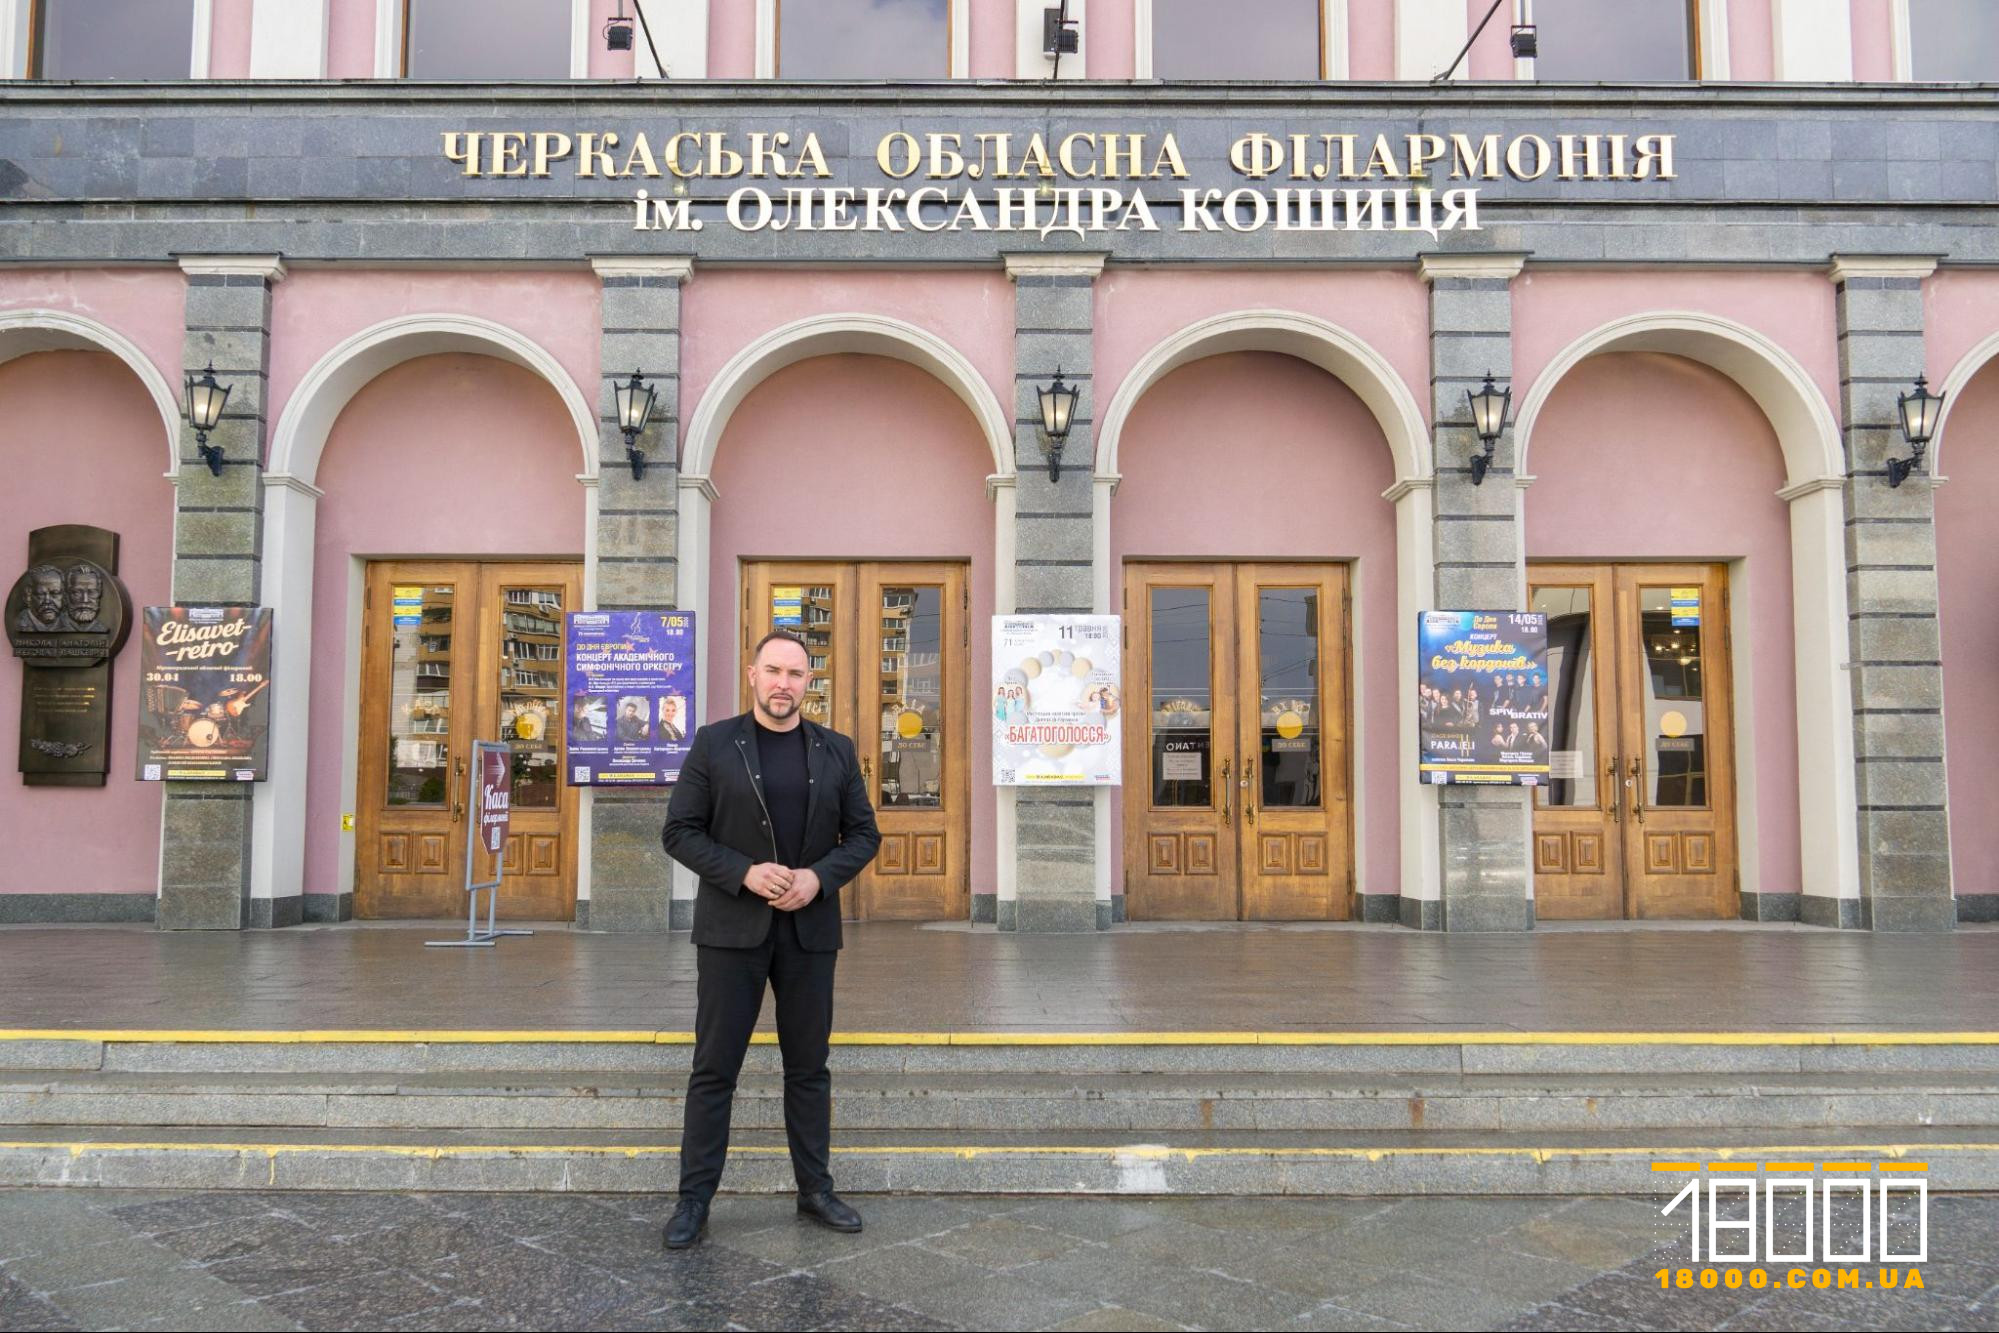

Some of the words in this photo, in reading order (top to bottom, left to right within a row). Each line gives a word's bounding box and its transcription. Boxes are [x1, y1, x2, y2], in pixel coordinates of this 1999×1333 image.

[441, 132, 833, 177] ЧЕРКАСЬКА
[877, 132, 1190, 178] ОБЛАСНА
[1230, 133, 1678, 179] ФІЛАРМОНІЯ
[633, 189, 704, 231] ім.
[726, 187, 1160, 242] ОЛЕКСАНДРА
[1177, 188, 1484, 242] КОШИЦЯ
[660, 616, 684, 628] 7/05
[1508, 613, 1537, 625] 14/05
[1059, 625, 1074, 639] 11
[576, 643, 586, 651] ДО
[587, 643, 600, 651] ДНЯ
[576, 653, 612, 662] КОНЦЕРТ
[613, 653, 675, 662] АКАДЕМІЧНОГО
[576, 662, 641, 671] СИМФОНІЧНОГО
[642, 662, 683, 671] ОРКЕСТРУ
[1432, 655, 1458, 673] без
[230, 673, 263, 682] 18.00
[1489, 707, 1514, 716] SPIV
[1510, 711, 1548, 719] BRATIV
[1005, 725, 1109, 743] «БАГАТОГОЛОССЯ»
[484, 784, 509, 810] Каса
